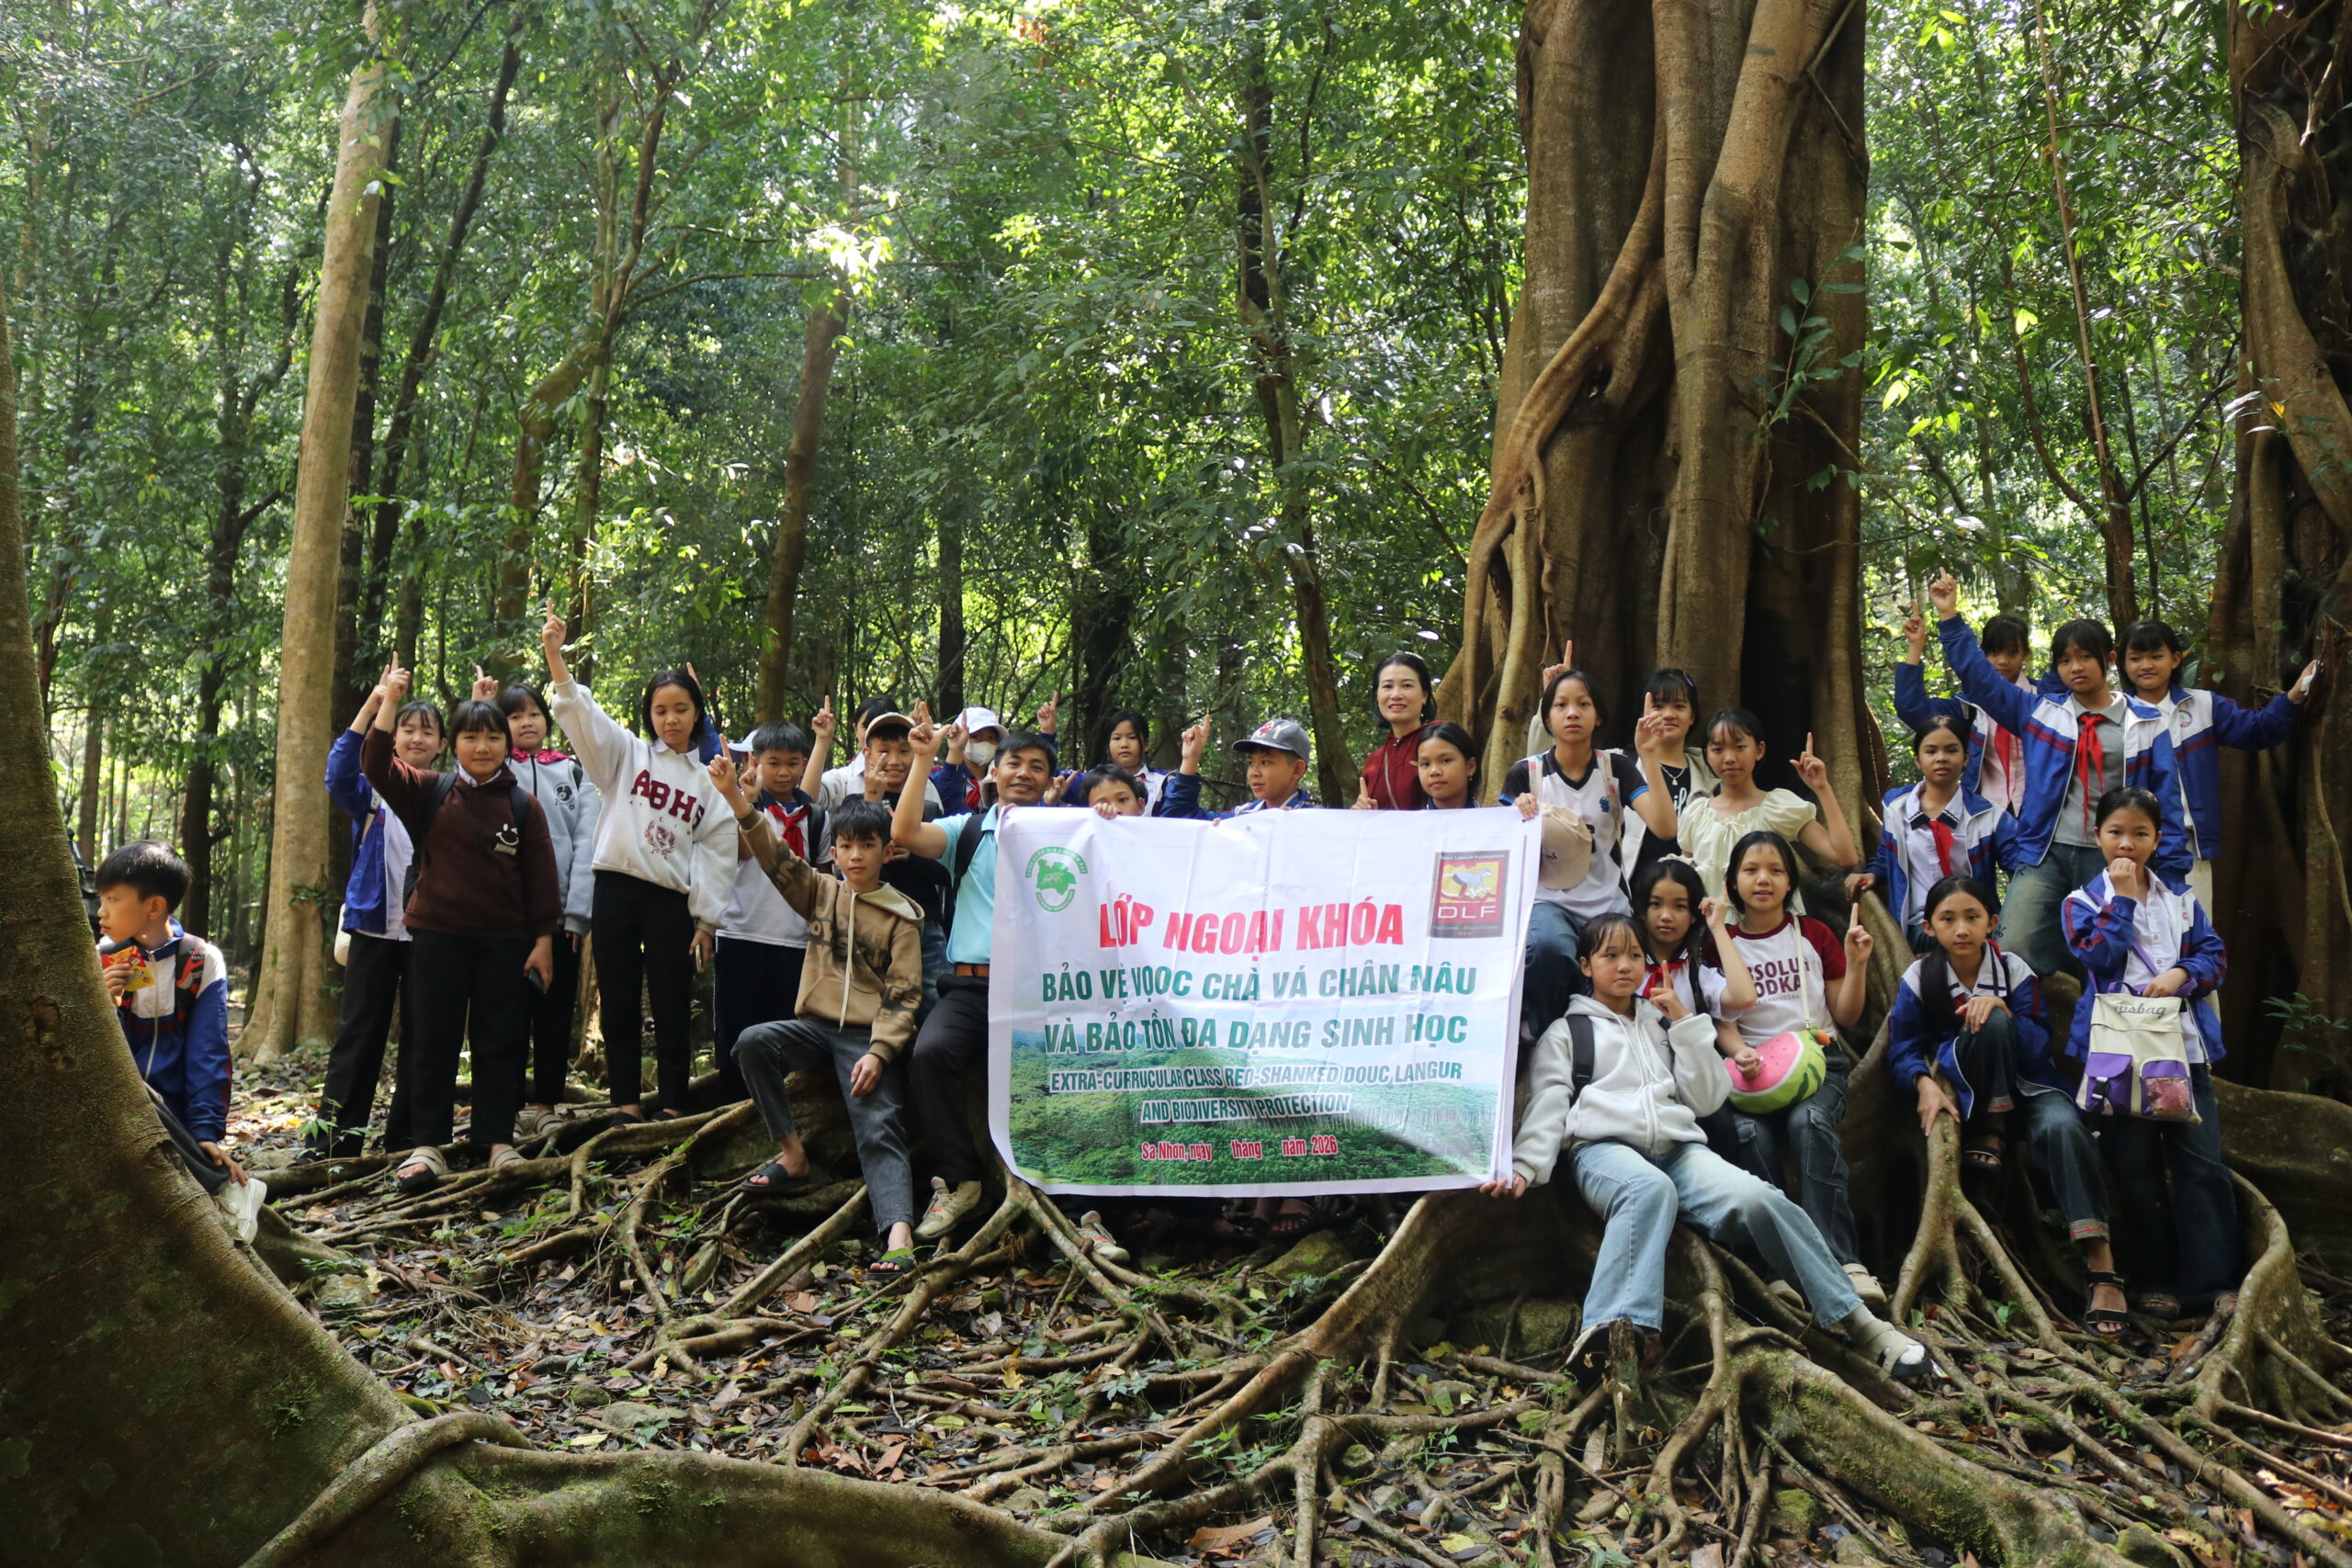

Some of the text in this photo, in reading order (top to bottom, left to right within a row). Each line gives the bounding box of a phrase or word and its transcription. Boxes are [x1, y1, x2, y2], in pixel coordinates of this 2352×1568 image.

[1438, 906, 1497, 919] DLF
[1100, 893, 1154, 948] LỚP
[1162, 908, 1284, 962] NGOẠI
[1296, 896, 1404, 951] KHÓA
[1043, 962, 1092, 1002] BẢO
[1131, 965, 1193, 1003] VỌOC
[1202, 967, 1261, 1001] CHÀ
[1272, 965, 1307, 998] VÁ
[1318, 959, 1400, 998] CHÂN
[1410, 961, 1477, 995] NÂU
[1754, 974, 1801, 998] ODKA
[1044, 1009, 1468, 1055] VÀ BẢO TỒN ĐA DẠNG SINH HỌC
[1184, 1067, 1224, 1088] CLASS
[1226, 1066, 1340, 1089] RED-SHANKED
[1395, 1060, 1463, 1083] LANGUR
[1142, 1094, 1350, 1122] AND BIODIVERSITY PROTECTION
[1141, 1135, 1338, 1162] Sa Nhơn, ngày tháng năm 2026
